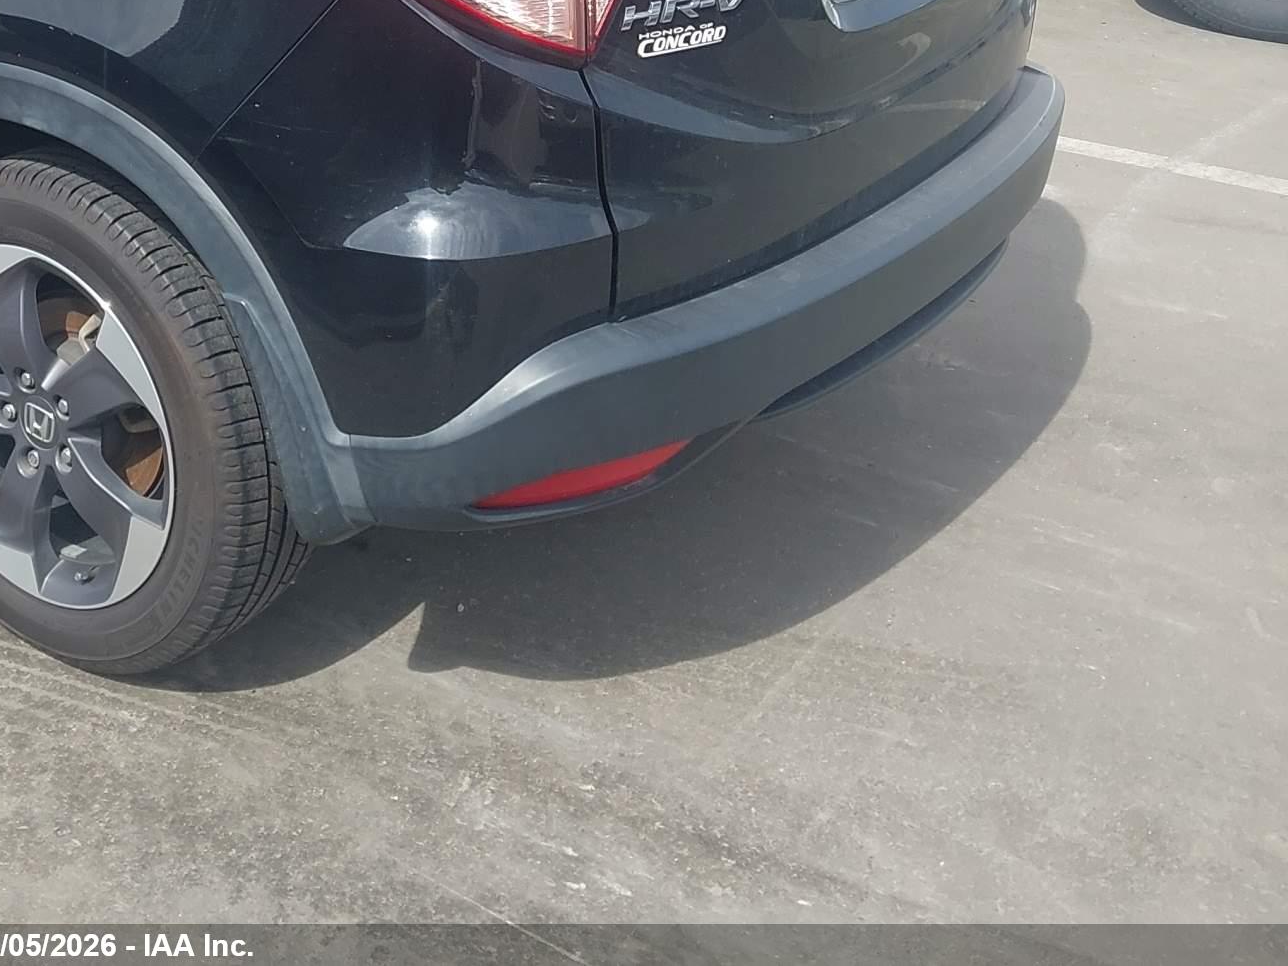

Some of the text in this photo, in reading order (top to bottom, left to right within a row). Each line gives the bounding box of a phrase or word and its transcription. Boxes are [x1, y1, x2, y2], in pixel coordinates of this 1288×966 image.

[637, 25, 727, 58] CONCORD
[638, 22, 713, 40] HONDA OF
